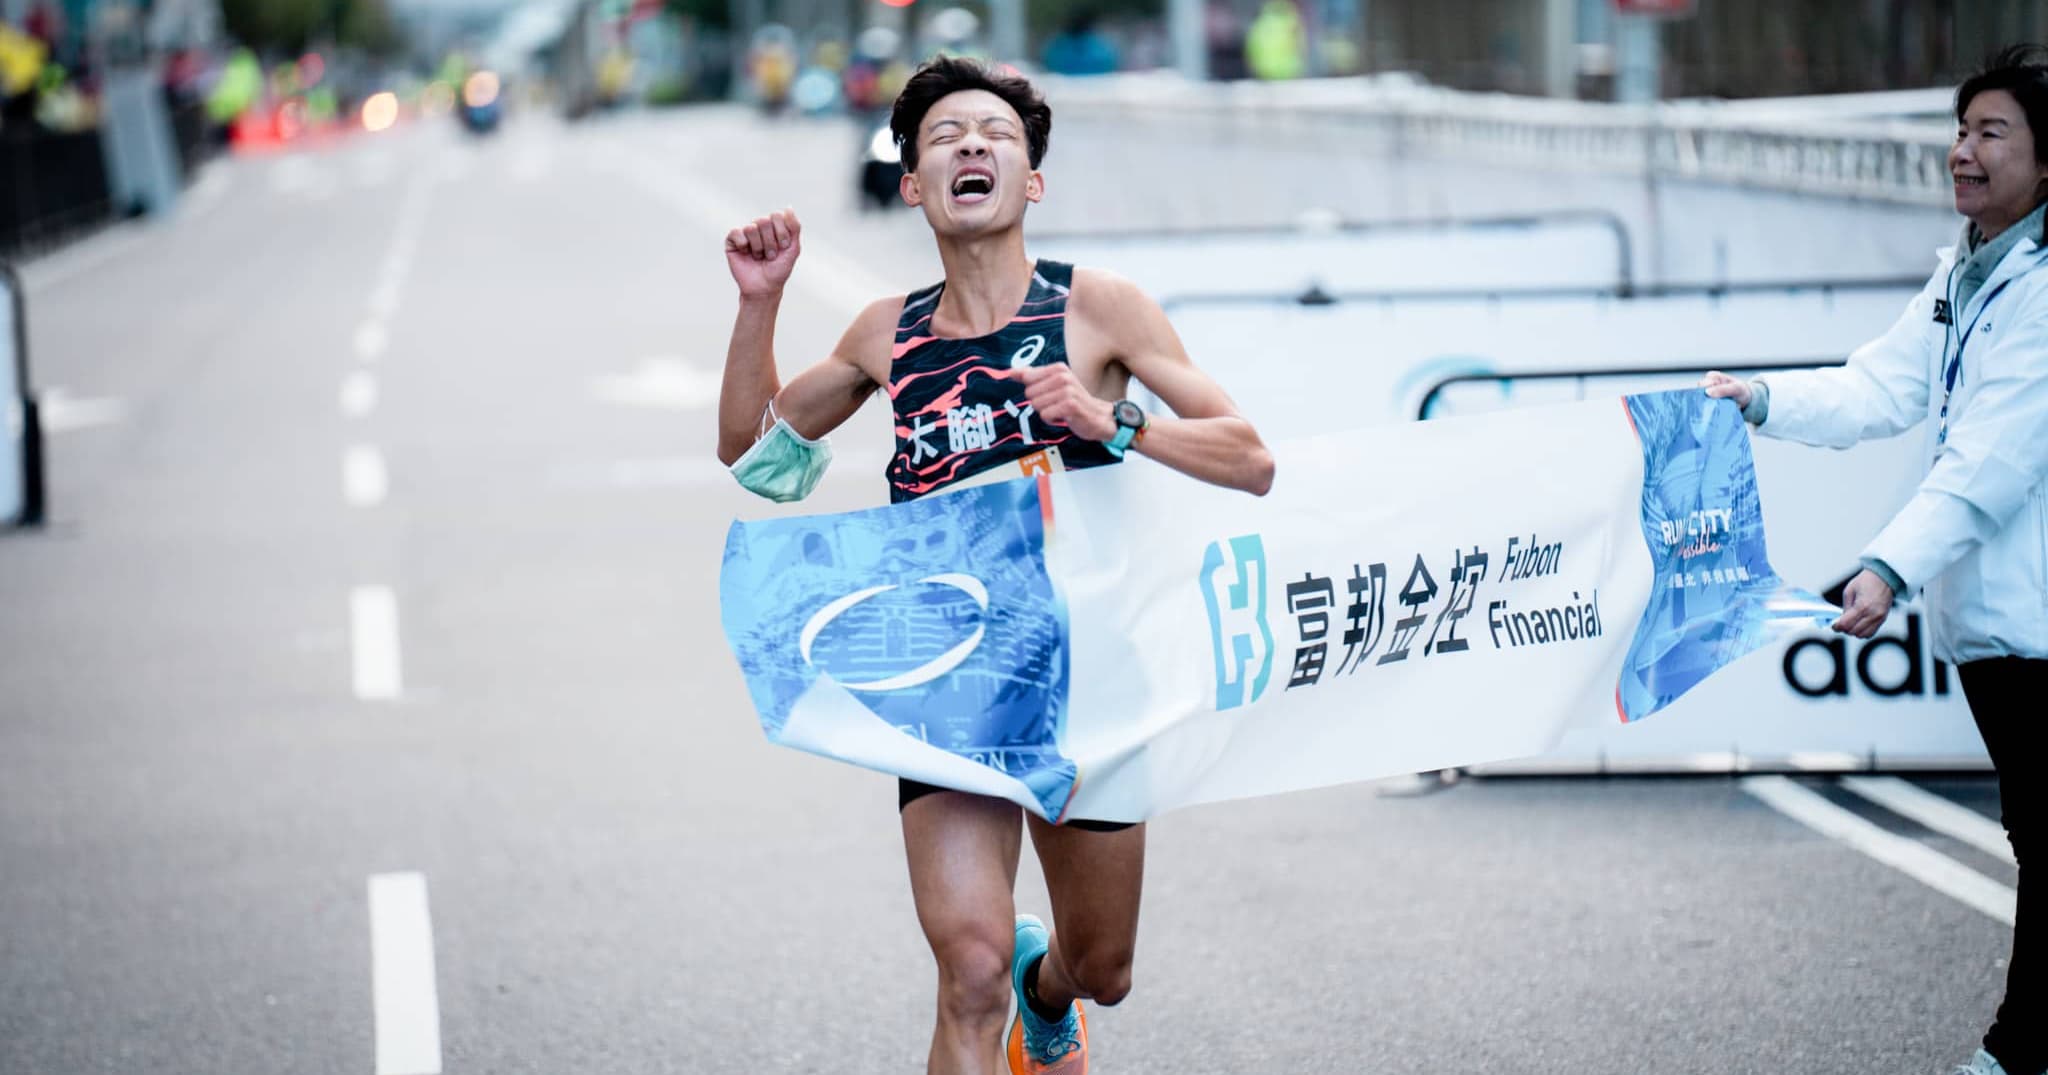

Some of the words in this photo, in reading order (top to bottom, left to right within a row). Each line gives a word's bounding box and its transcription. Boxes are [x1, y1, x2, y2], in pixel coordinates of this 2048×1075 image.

[1687, 507, 1732, 536] CITY
[1498, 533, 1562, 583] Fubon
[1284, 545, 1489, 692] 富邦金控
[1488, 588, 1602, 649] Financial
